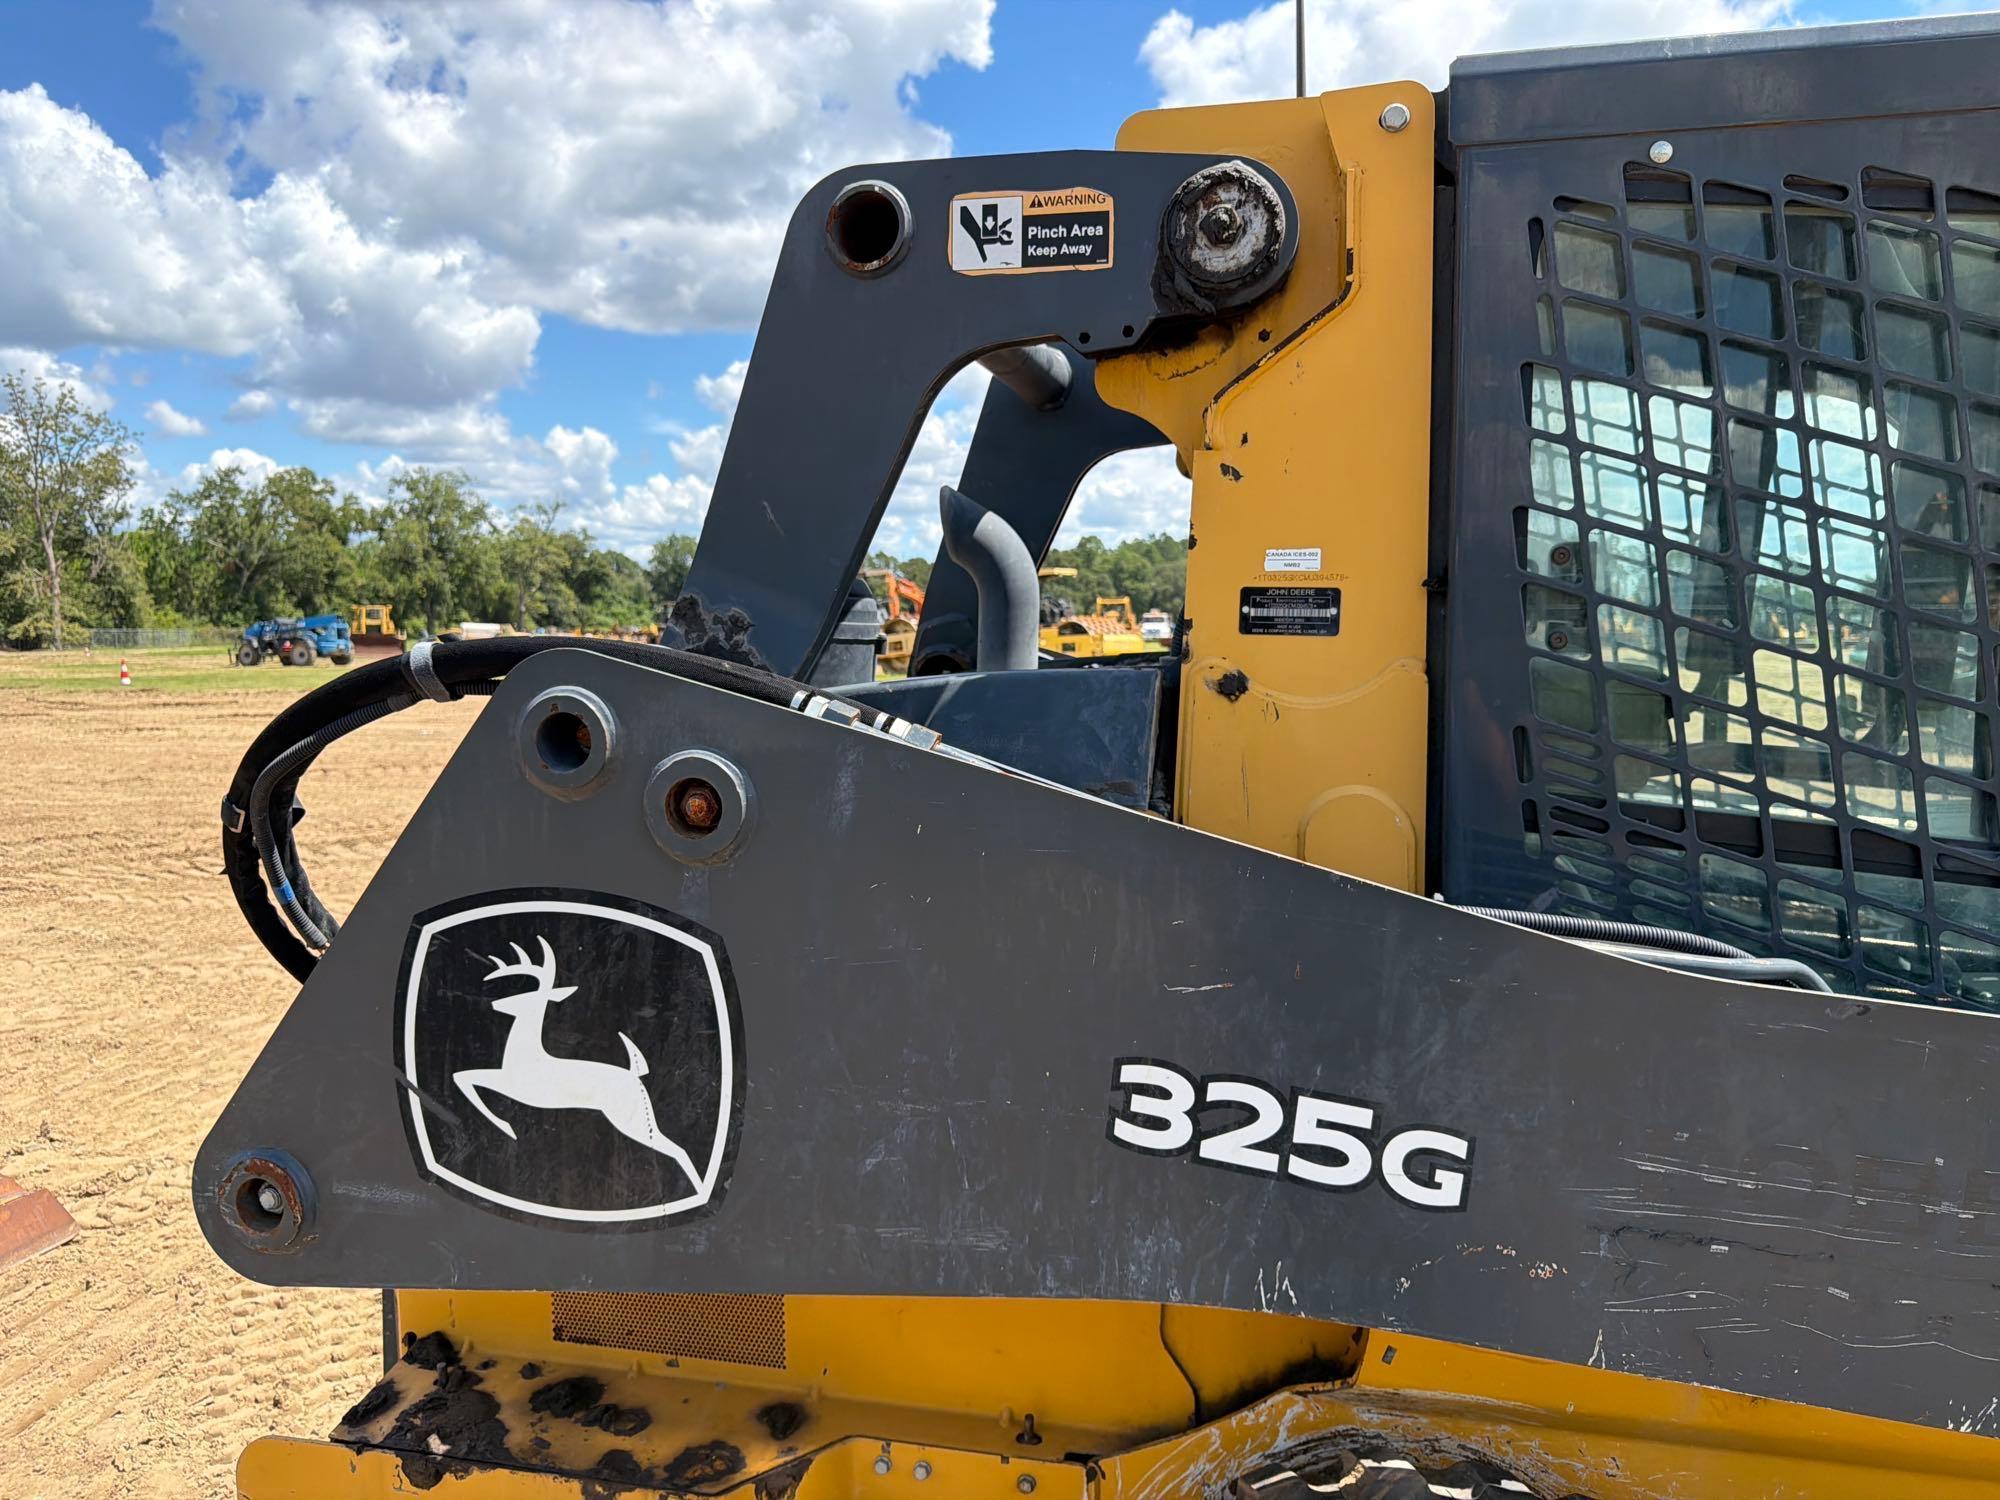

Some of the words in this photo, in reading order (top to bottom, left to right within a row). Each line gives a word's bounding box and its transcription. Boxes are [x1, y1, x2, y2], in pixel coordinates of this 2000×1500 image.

[1043, 193, 1106, 207] WARNING
[1028, 225, 1068, 239] Pinch
[1070, 224, 1104, 237] Area
[1027, 245, 1057, 258] Keep
[1060, 244, 1093, 256] Away
[1112, 1063, 1469, 1208] 325G
